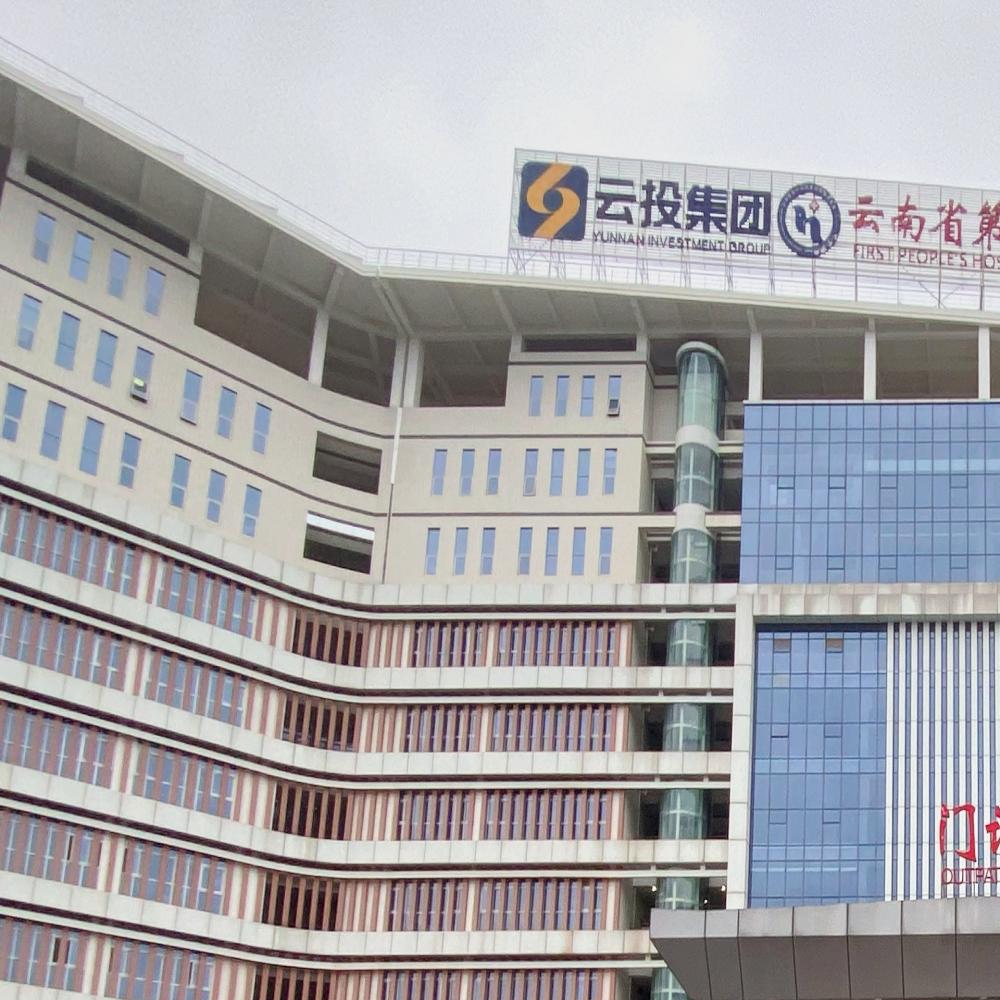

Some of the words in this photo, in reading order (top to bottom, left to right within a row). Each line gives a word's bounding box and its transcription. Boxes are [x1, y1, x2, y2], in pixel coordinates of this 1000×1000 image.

[595, 176, 772, 237] 云投集团
[592, 231, 645, 246] YUNNAN
[648, 235, 725, 251] INVESTMENT
[729, 242, 771, 255] GROUP
[853, 243, 893, 261] FIRST
[899, 248, 967, 268] PEOPLE'S
